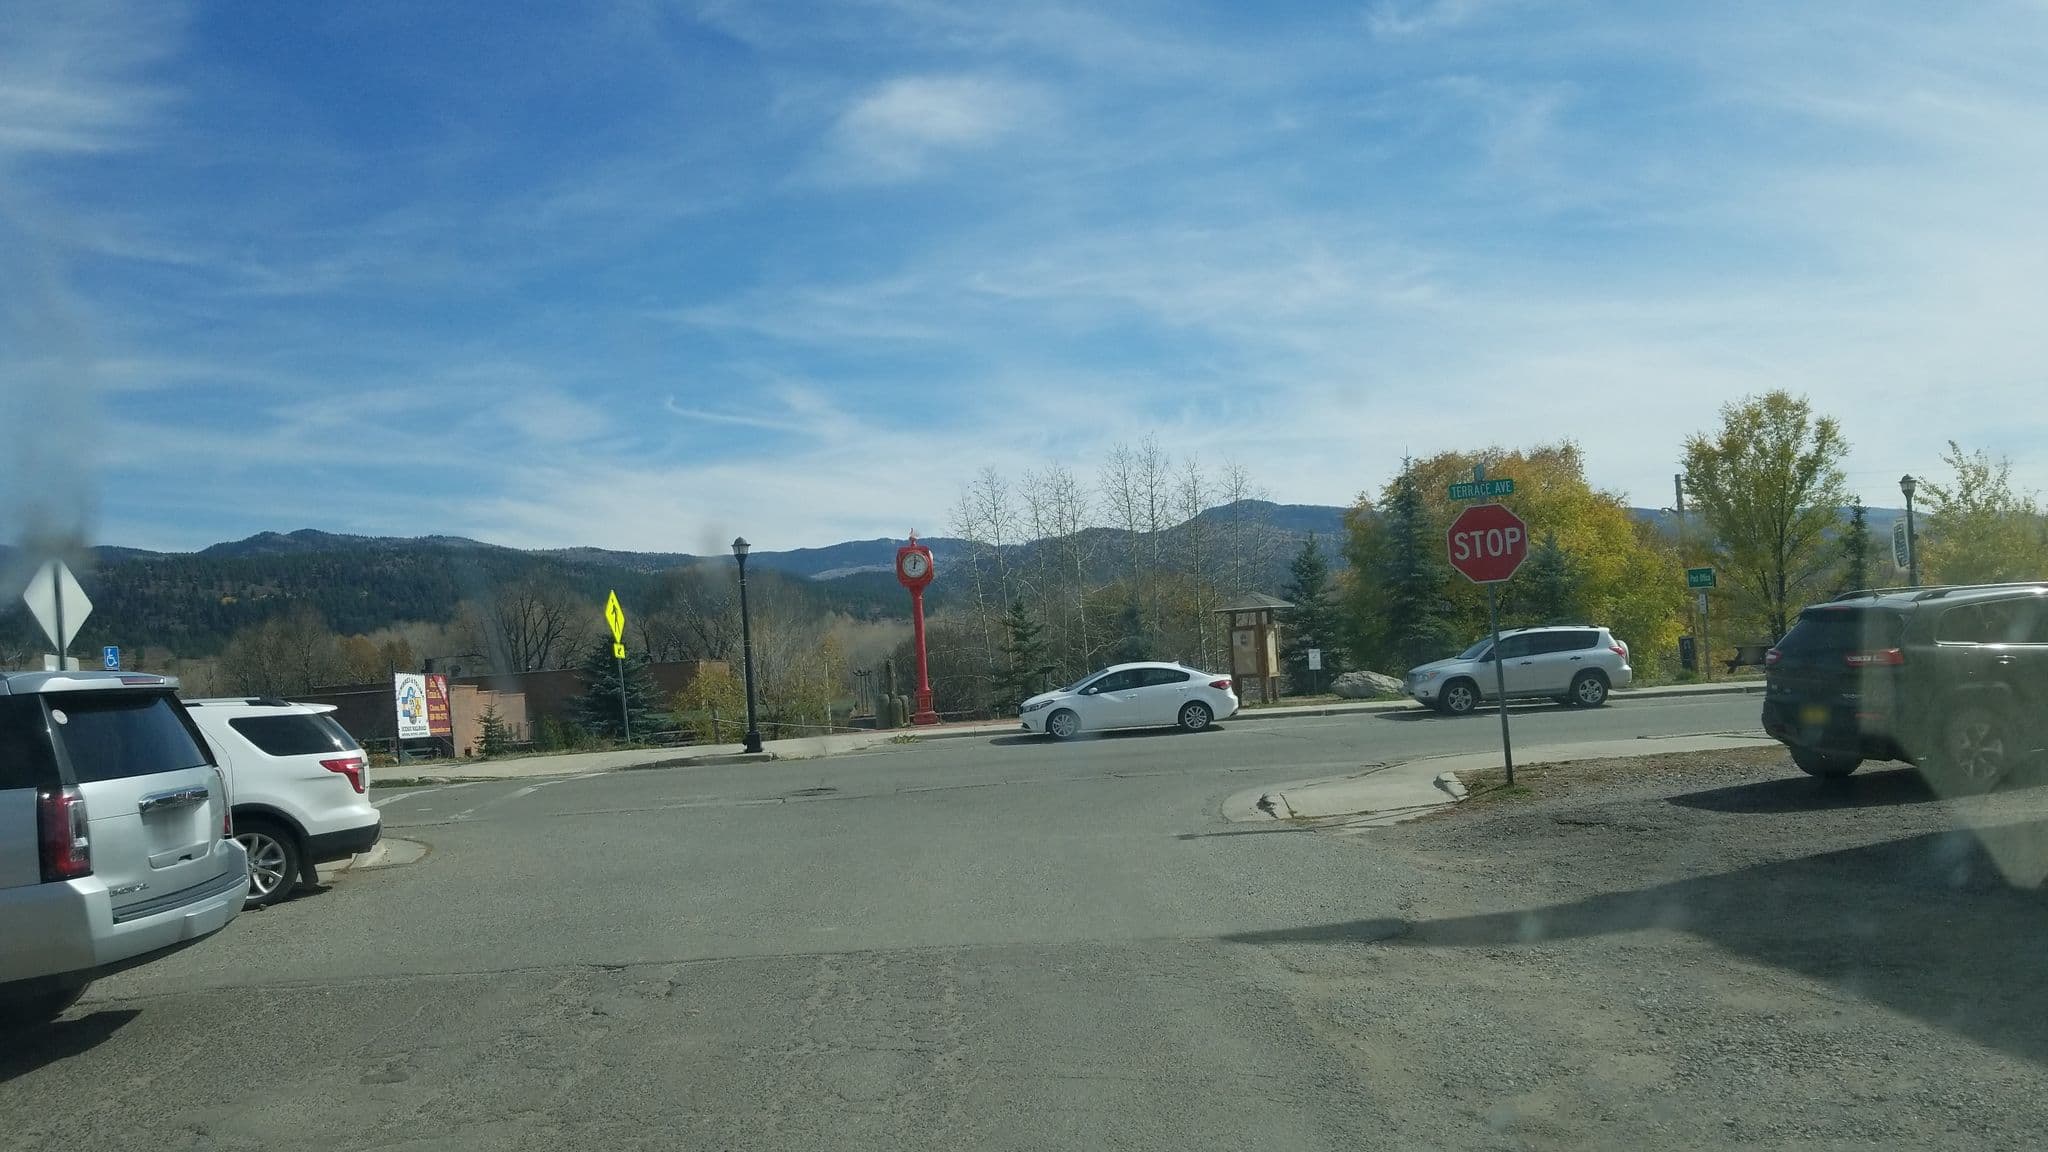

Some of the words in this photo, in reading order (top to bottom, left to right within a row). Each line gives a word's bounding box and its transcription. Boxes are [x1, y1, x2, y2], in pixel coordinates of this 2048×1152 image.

[1451, 483, 1491, 498] TERRACE
[1495, 481, 1512, 493] AVE
[1454, 527, 1521, 560] STOP
